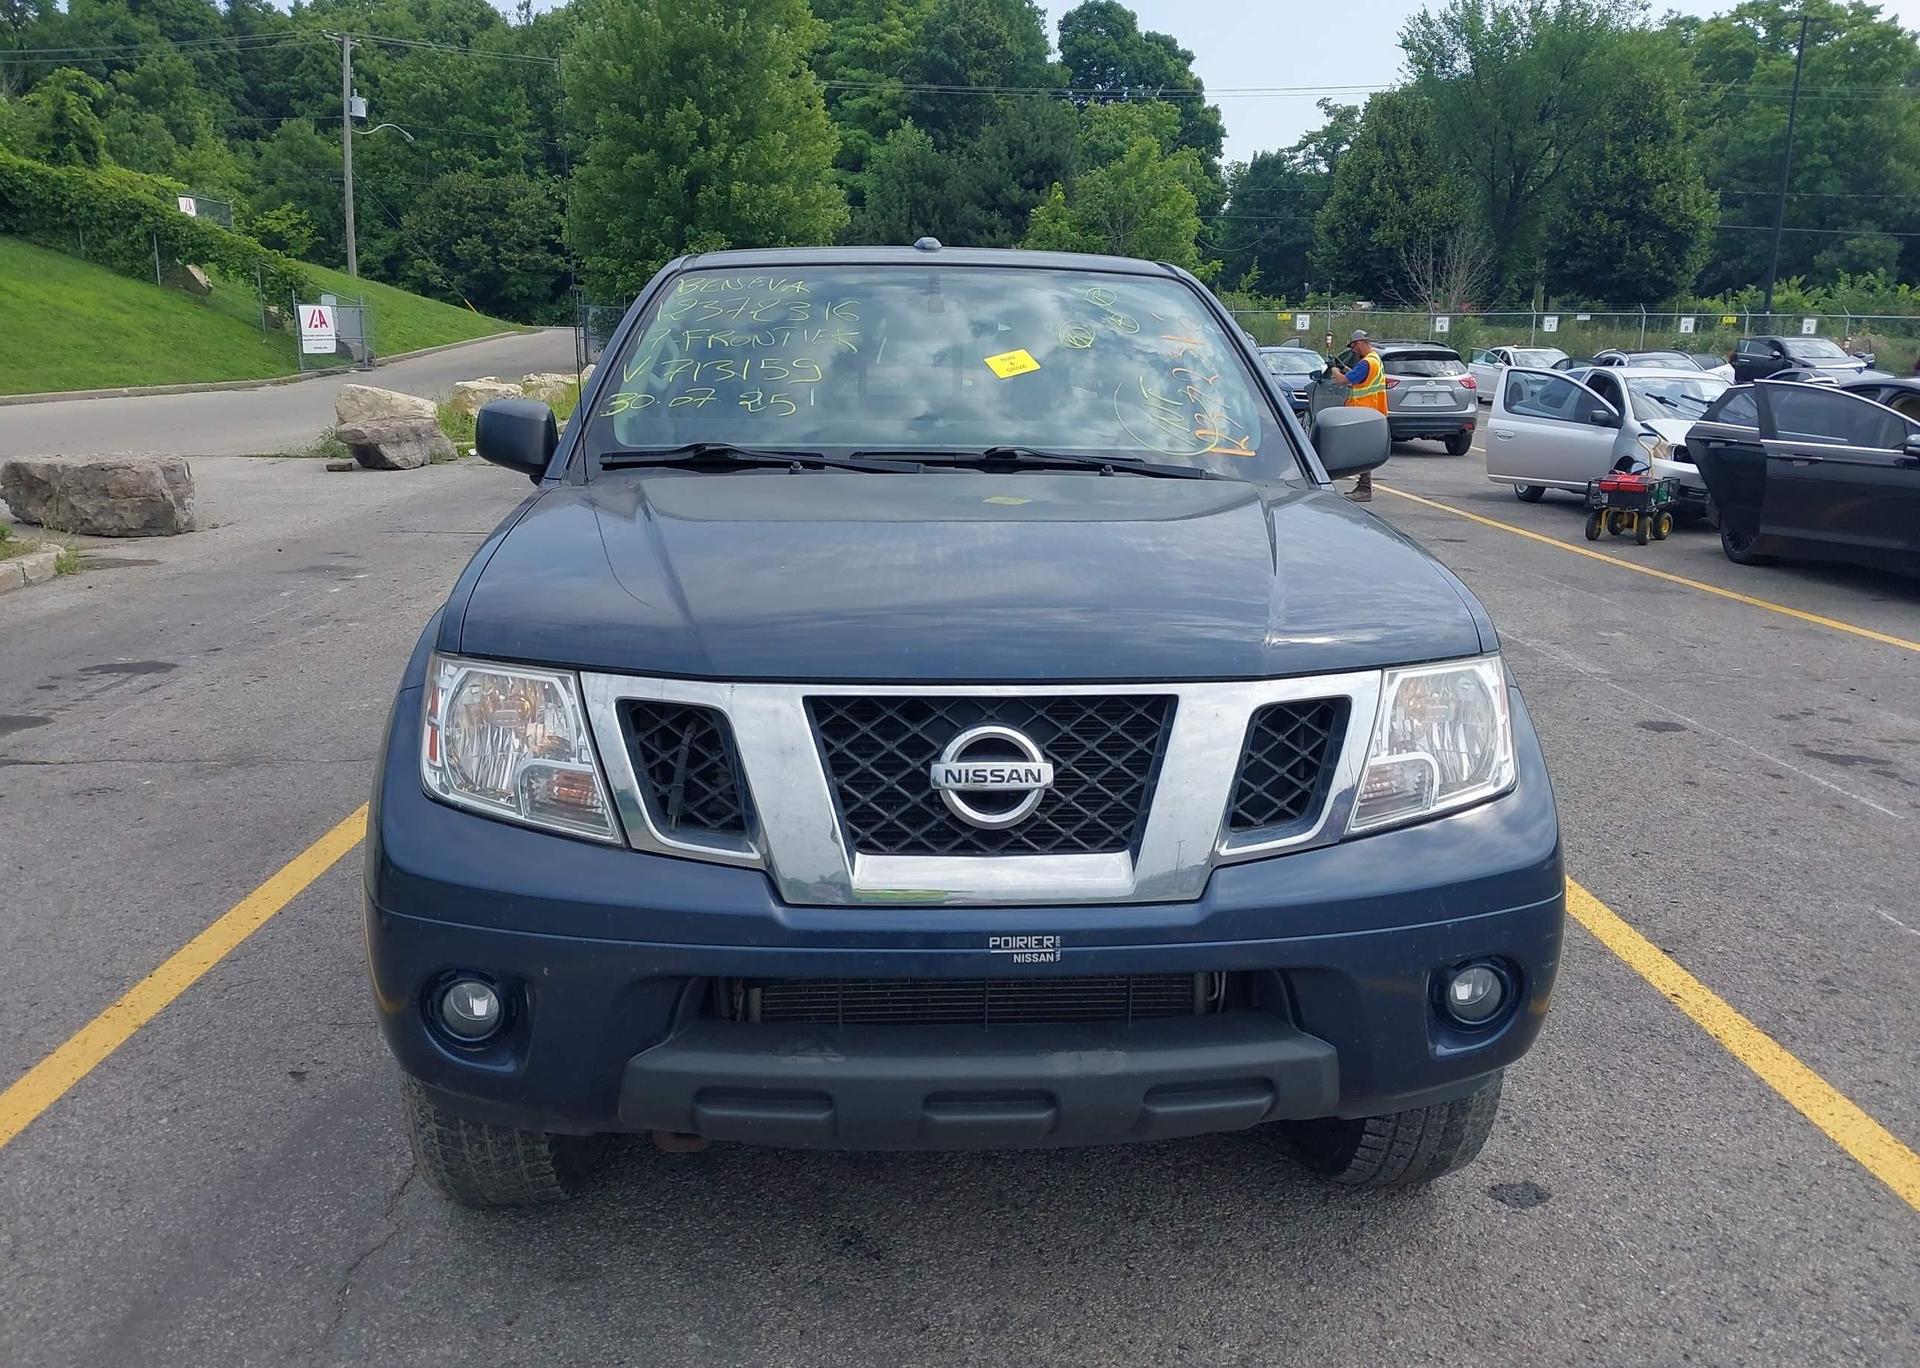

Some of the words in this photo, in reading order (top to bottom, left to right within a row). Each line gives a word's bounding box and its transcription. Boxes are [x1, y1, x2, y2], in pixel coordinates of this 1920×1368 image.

[1300, 321, 1305, 329] 5
[944, 768, 1042, 785] NISSAN
[989, 935, 1054, 949] POIRIER
[1013, 952, 1055, 964] NISSAN
